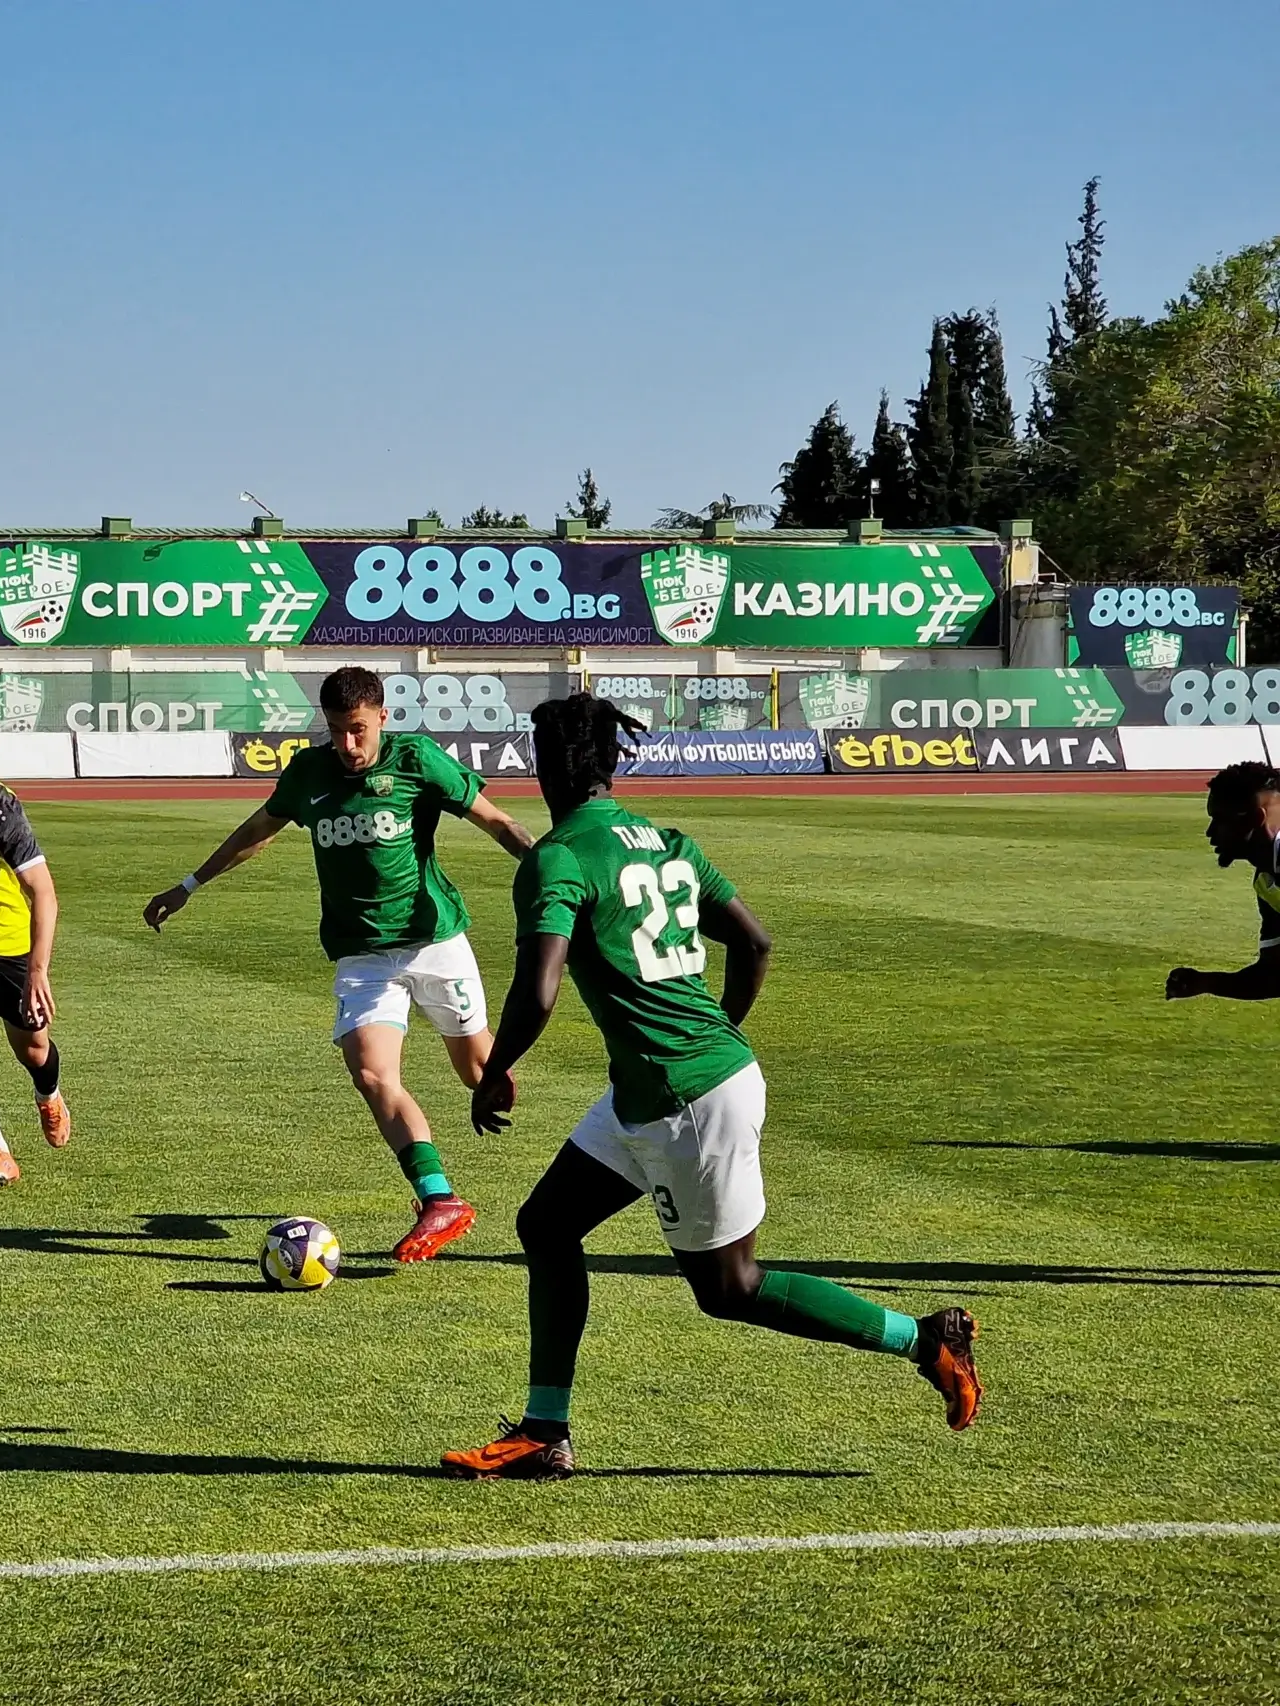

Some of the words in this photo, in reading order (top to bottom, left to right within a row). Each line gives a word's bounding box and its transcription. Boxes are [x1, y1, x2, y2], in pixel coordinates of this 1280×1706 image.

[0, 573, 32, 589] ПФК
[345, 545, 620, 622] 8888.BG
[652, 574, 685, 590] ПФК
[81, 582, 252, 617] СПОРТ
[734, 582, 925, 616] КАЗИНО
[1089, 588, 1225, 628] 8888.BG
[22, 627, 47, 639] 1916
[313, 626, 376, 643] ХАЗАРТЪТ
[378, 626, 414, 643] НОСИ
[417, 627, 452, 643] РИСК
[453, 627, 471, 643] ОТ
[472, 627, 546, 643] РАЗВИВАНЕ
[547, 627, 566, 643] НА
[567, 627, 653, 643] ЗАВИСИМОСТ
[675, 628, 698, 639] 1916
[66, 701, 224, 733] СПОРТ
[890, 699, 1038, 729] СПОРТ
[683, 741, 768, 762] ФУТБОЛЕН
[769, 741, 817, 761] СЪЮЗ
[840, 733, 977, 768] efbet
[986, 737, 1118, 766] ЛИГА
[611, 825, 667, 851] TIJAN
[619, 860, 707, 983] 23
[454, 978, 471, 1011] 5
[654, 1184, 680, 1224] 3
